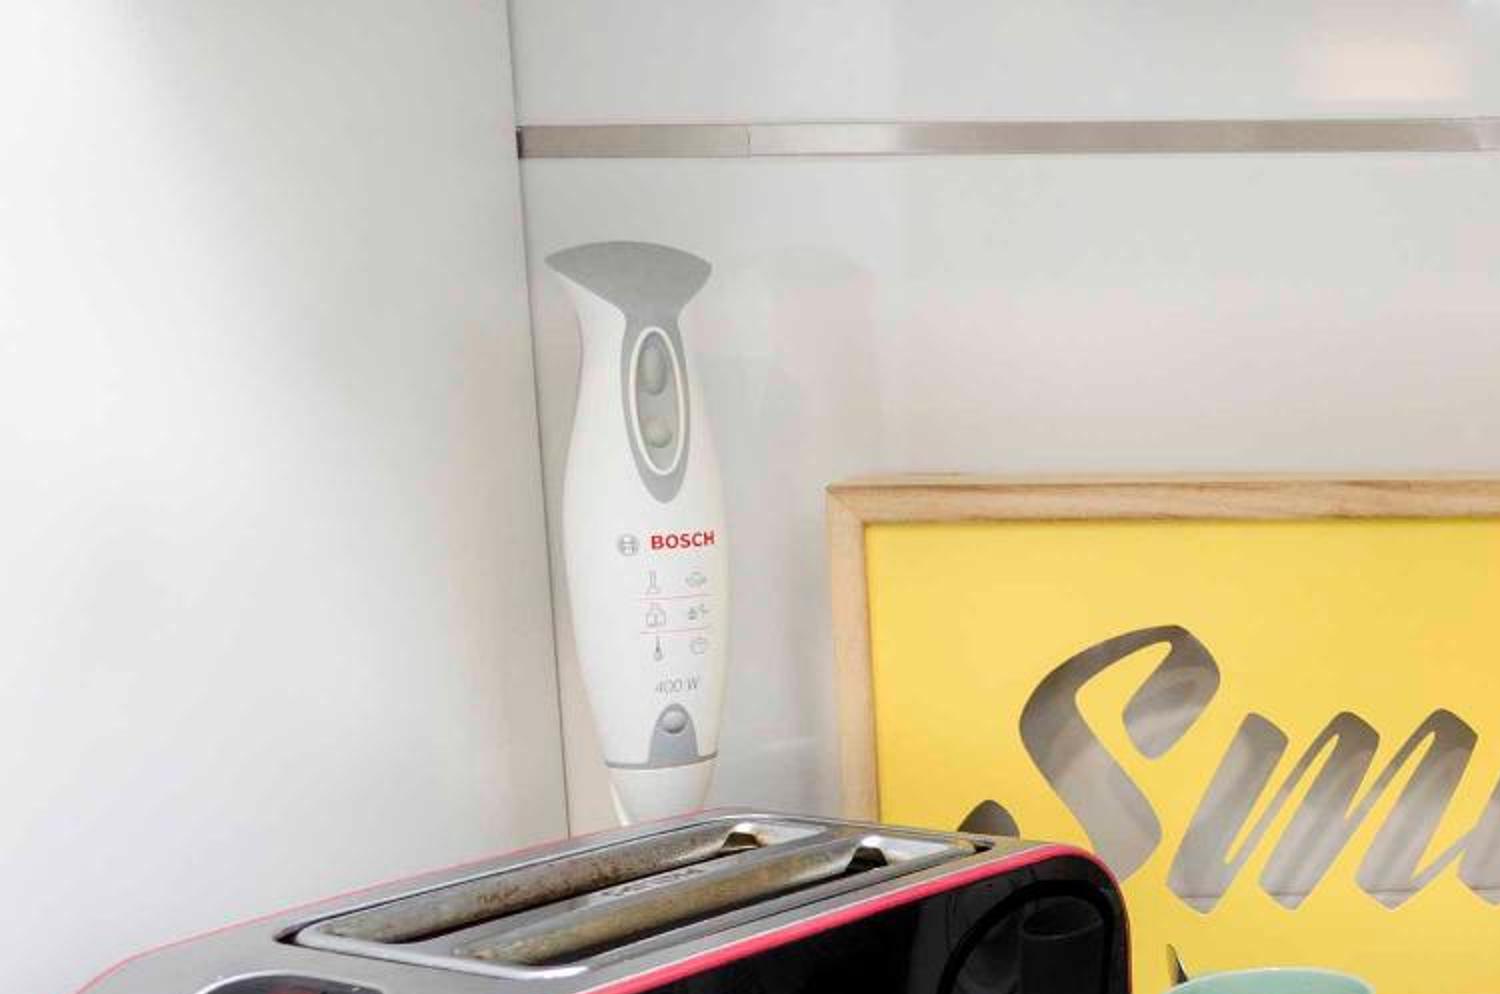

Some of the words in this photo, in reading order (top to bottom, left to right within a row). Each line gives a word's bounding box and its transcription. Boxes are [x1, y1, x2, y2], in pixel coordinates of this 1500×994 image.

[650, 530, 715, 550] BOSCH
[655, 677, 684, 694] 400
[686, 676, 702, 691] W
